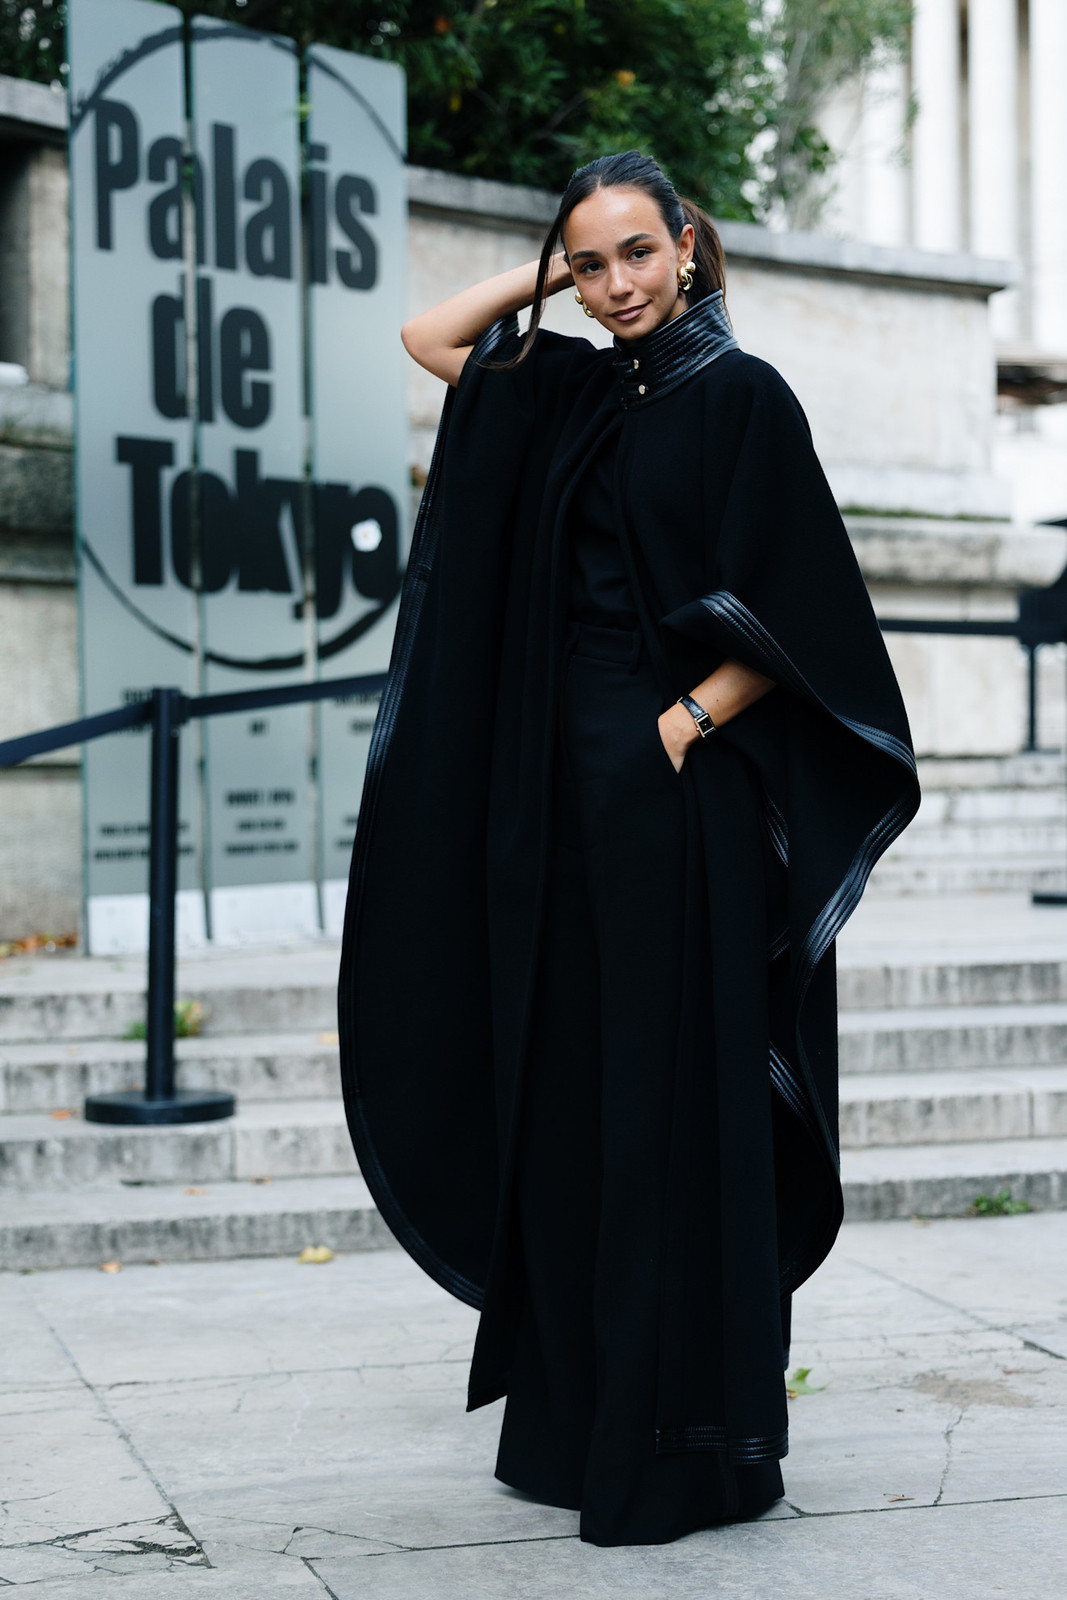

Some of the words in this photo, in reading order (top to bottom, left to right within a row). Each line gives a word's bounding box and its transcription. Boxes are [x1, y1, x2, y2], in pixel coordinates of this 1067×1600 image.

[94, 97, 380, 292] Palais
[151, 272, 272, 429] de
[115, 434, 400, 621] Tokyo
